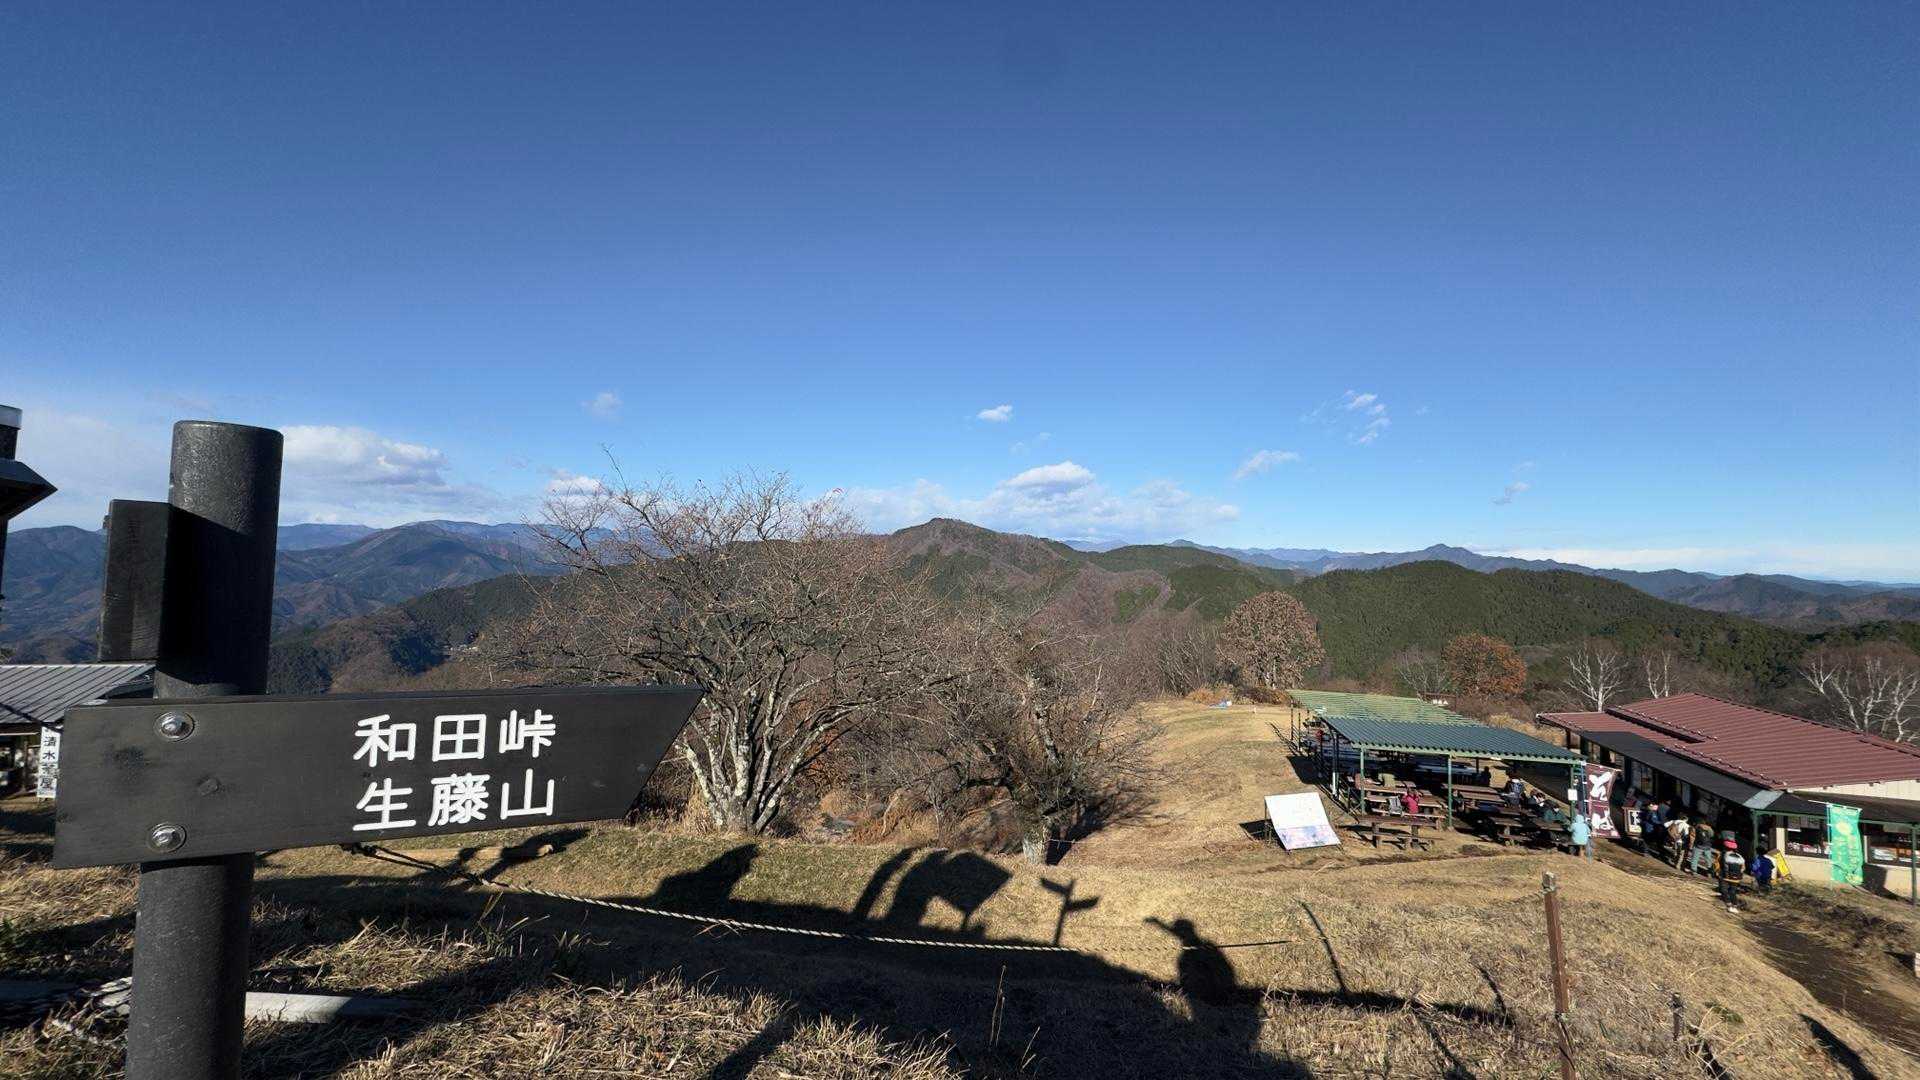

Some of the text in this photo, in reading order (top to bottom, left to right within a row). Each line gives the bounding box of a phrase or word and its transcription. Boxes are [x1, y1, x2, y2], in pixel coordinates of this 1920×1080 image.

[353, 709, 556, 767] 和田峠
[352, 768, 555, 831] 生藤山
